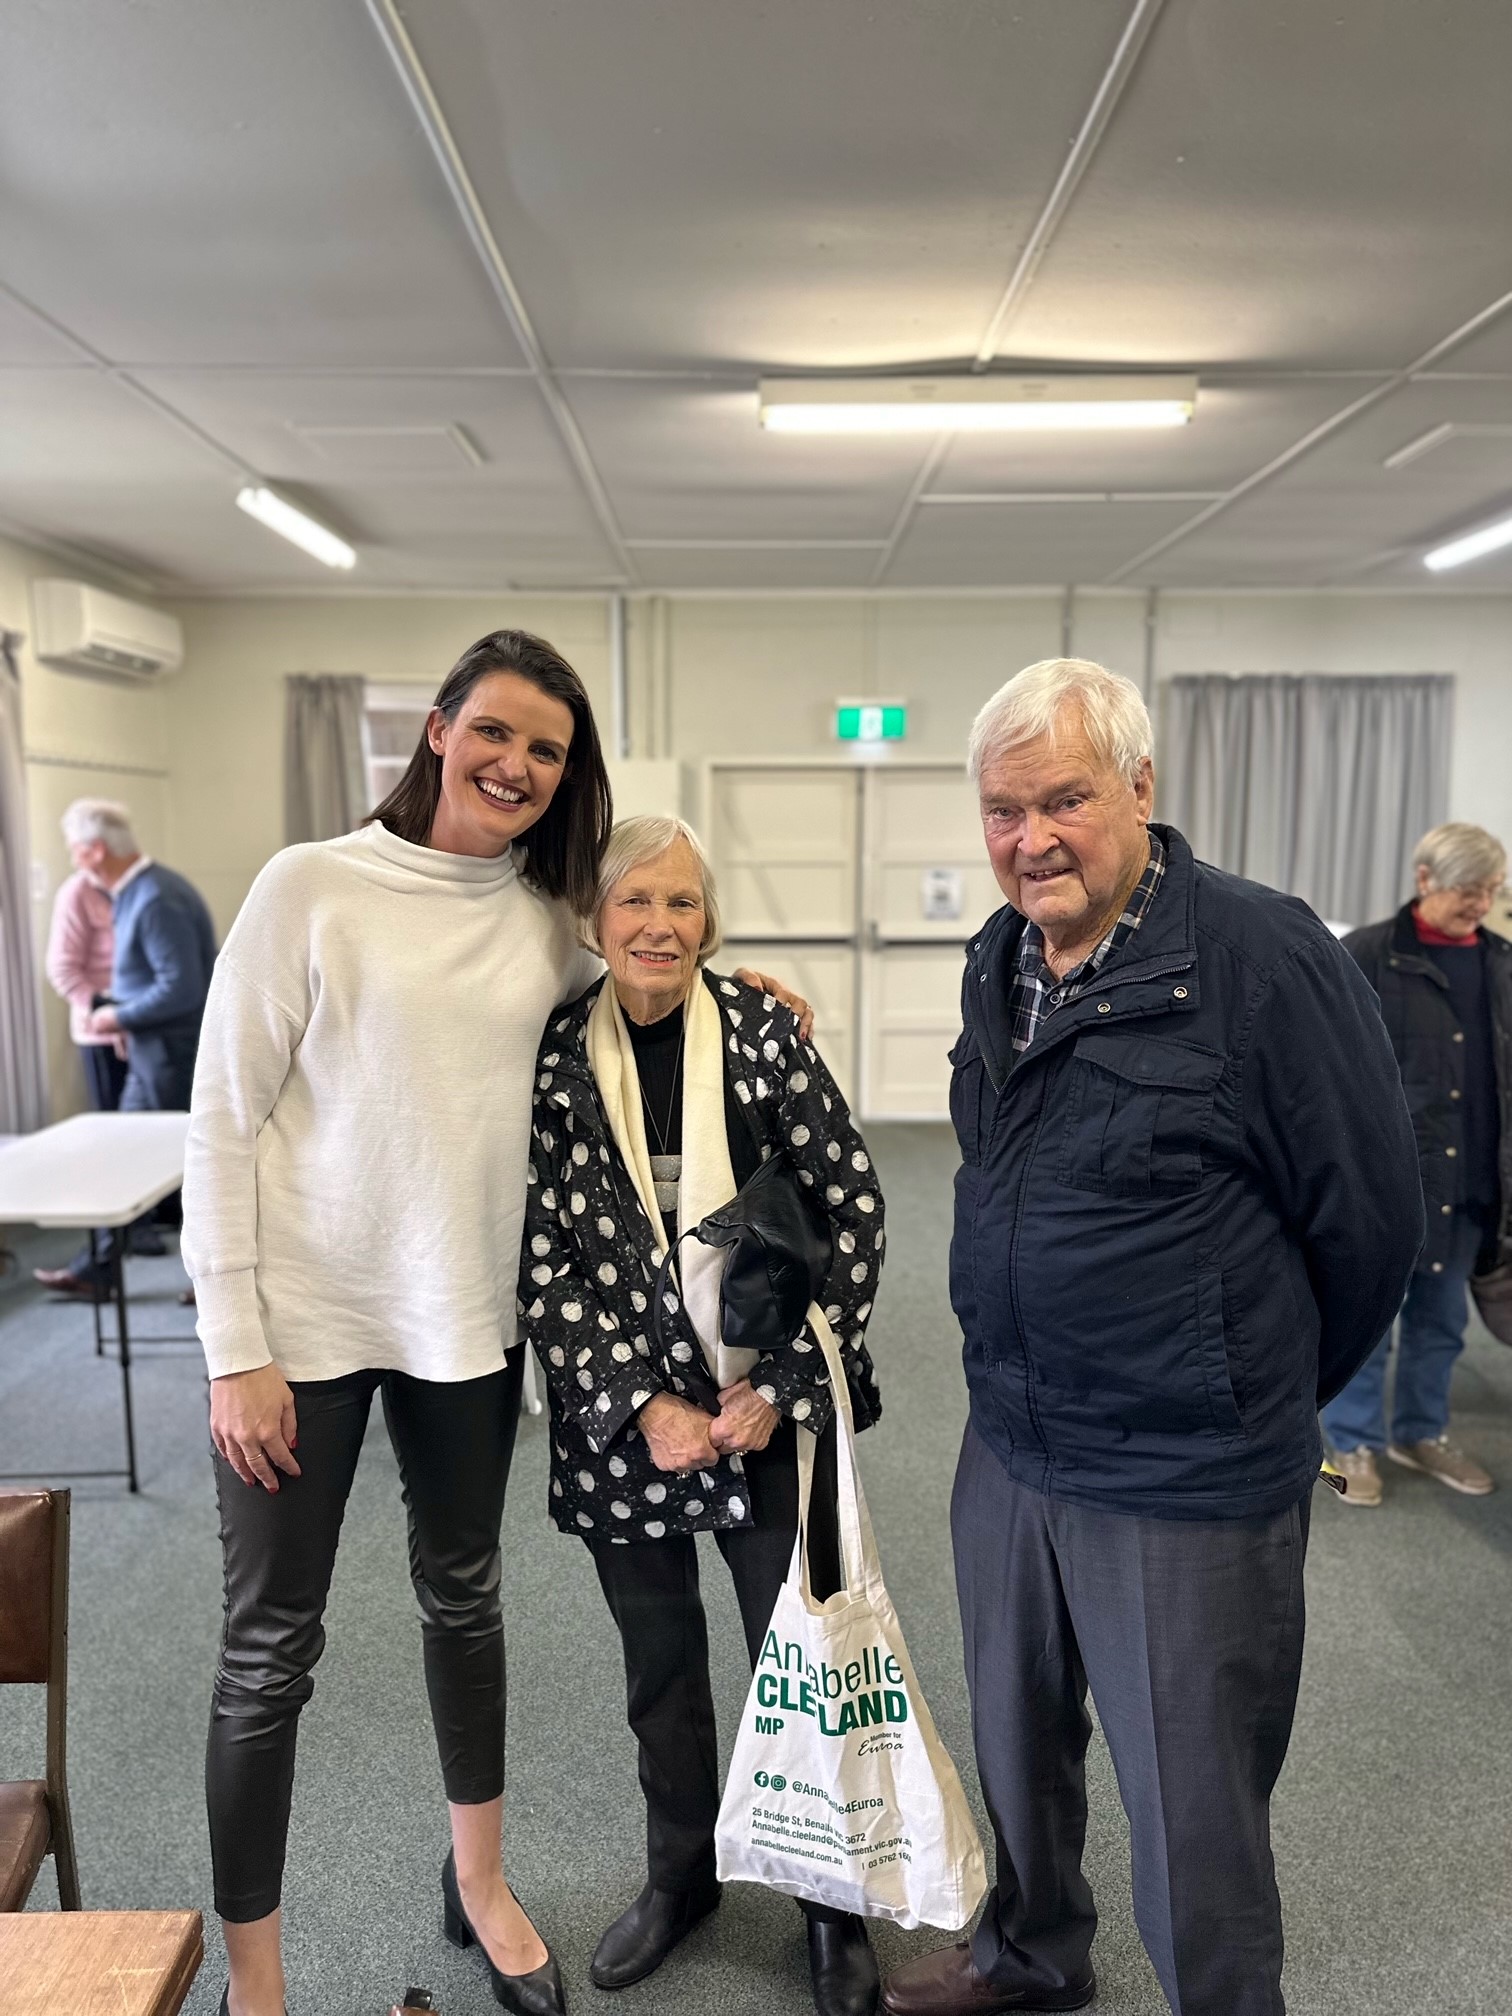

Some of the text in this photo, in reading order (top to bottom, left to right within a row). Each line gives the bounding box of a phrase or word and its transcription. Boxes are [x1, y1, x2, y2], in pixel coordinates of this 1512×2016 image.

[760, 1630, 904, 1699] Anabelle
[757, 1673, 908, 1737] CLELAND
[755, 1715, 785, 1735] MP
[870, 1732, 892, 1742] Member
[858, 1740, 904, 1756] Euroa
[792, 1781, 884, 1814] @Annaelle4Euroa
[752, 1807, 762, 1817] 25
[764, 1809, 790, 1824] Bridge
[791, 1815, 802, 1827] St,
[804, 1818, 833, 1834] Benalla
[845, 1833, 866, 1845] 3672
[751, 1838, 843, 1866] annabellecleeland.com.au
[868, 1859, 878, 1869] 03
[878, 1853, 897, 1865] 5762
